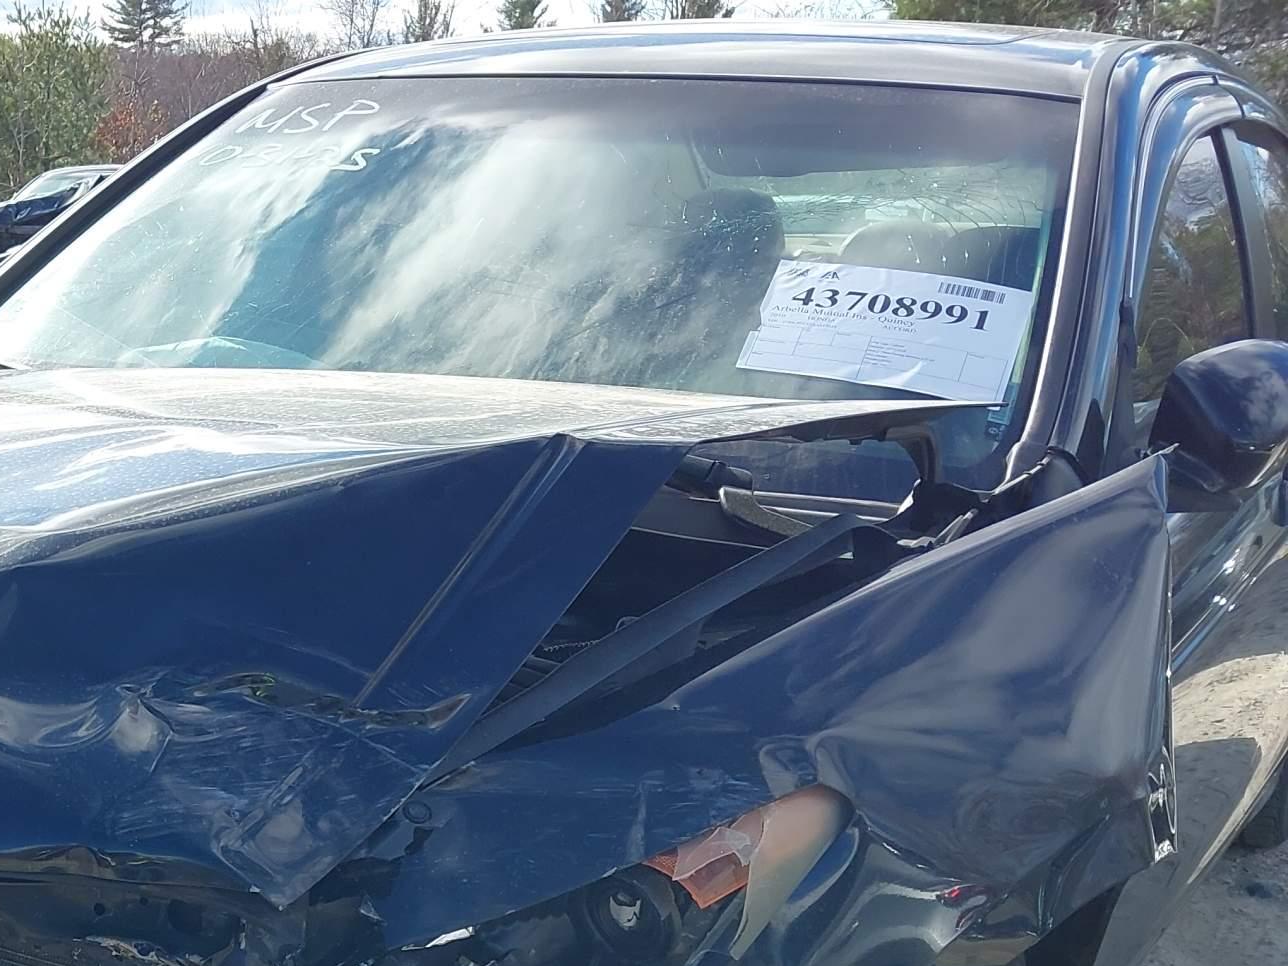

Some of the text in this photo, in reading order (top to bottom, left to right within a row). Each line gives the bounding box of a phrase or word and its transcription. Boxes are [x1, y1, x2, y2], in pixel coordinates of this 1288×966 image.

[771, 304, 809, 314] Arbella
[877, 316, 916, 327] Quincy
[791, 286, 992, 332] 43708991
